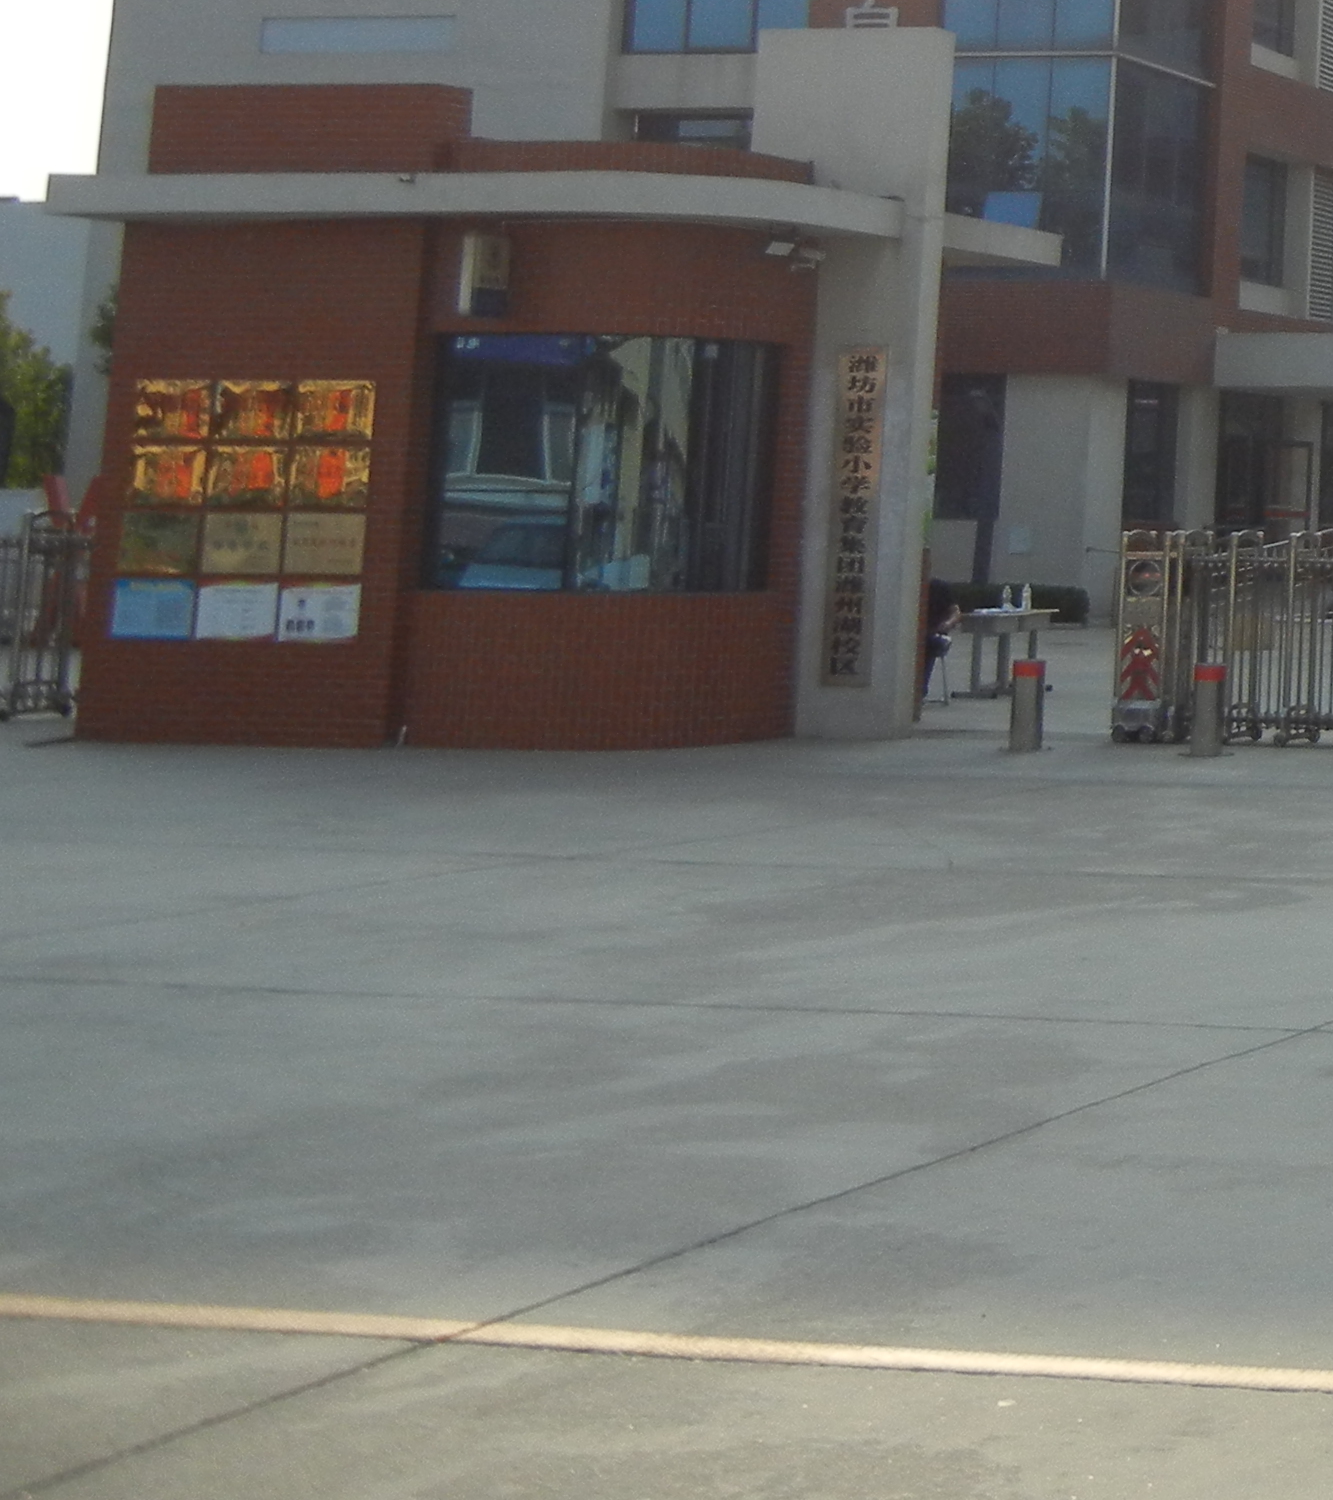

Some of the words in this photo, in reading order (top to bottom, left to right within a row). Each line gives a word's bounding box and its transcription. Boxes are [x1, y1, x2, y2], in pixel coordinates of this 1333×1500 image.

[829, 354, 879, 675] 潍坊市实验小学教育集团潍州湖校区
